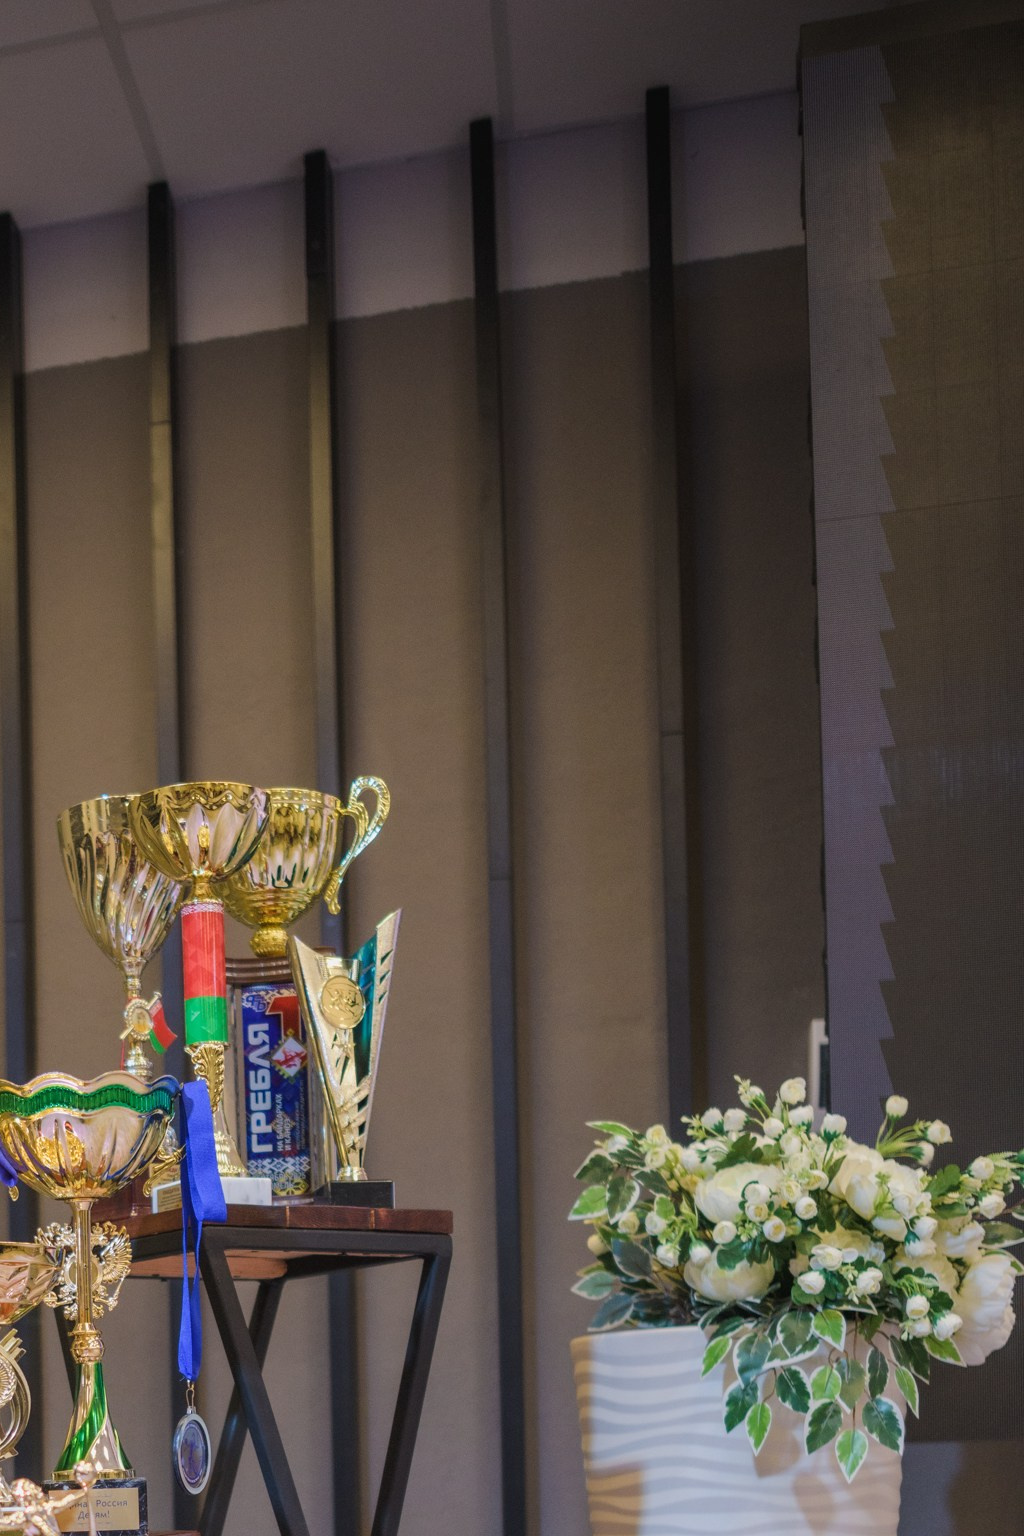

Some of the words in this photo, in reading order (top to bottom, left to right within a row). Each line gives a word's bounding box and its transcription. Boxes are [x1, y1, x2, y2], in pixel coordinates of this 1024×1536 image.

[247, 1023, 274, 1153] ГРЕБЛЯ
[96, 1499, 128, 1508] Россия
[78, 1510, 110, 1521] Деям!
